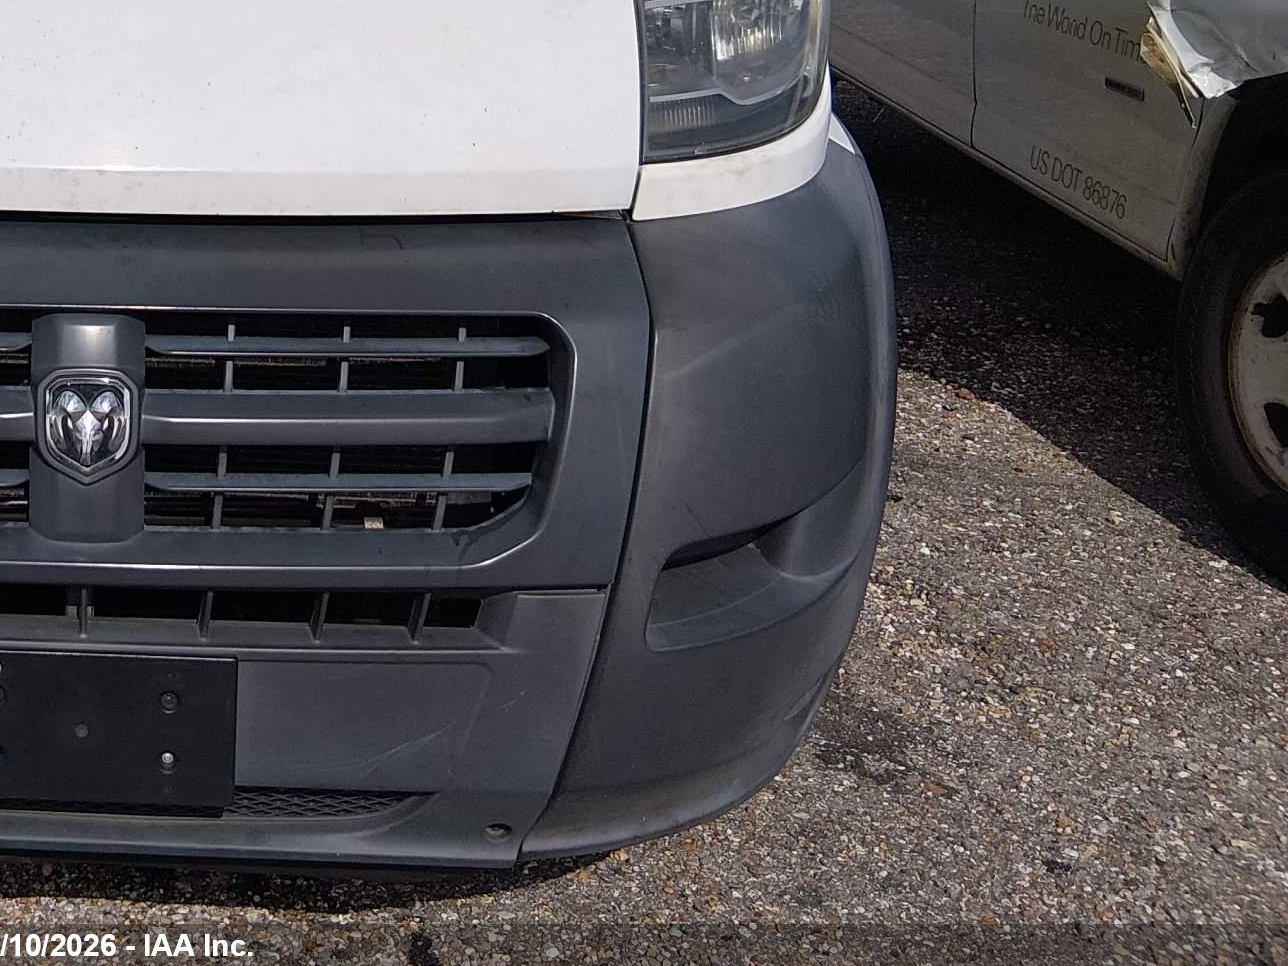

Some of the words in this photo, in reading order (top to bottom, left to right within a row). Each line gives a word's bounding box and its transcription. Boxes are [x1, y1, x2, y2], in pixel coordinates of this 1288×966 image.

[1090, 20, 1112, 50] On
[1114, 27, 1148, 65] Tim
[1030, 145, 1050, 175] US
[1051, 157, 1083, 193] DOT
[1082, 176, 1128, 219] 86876
